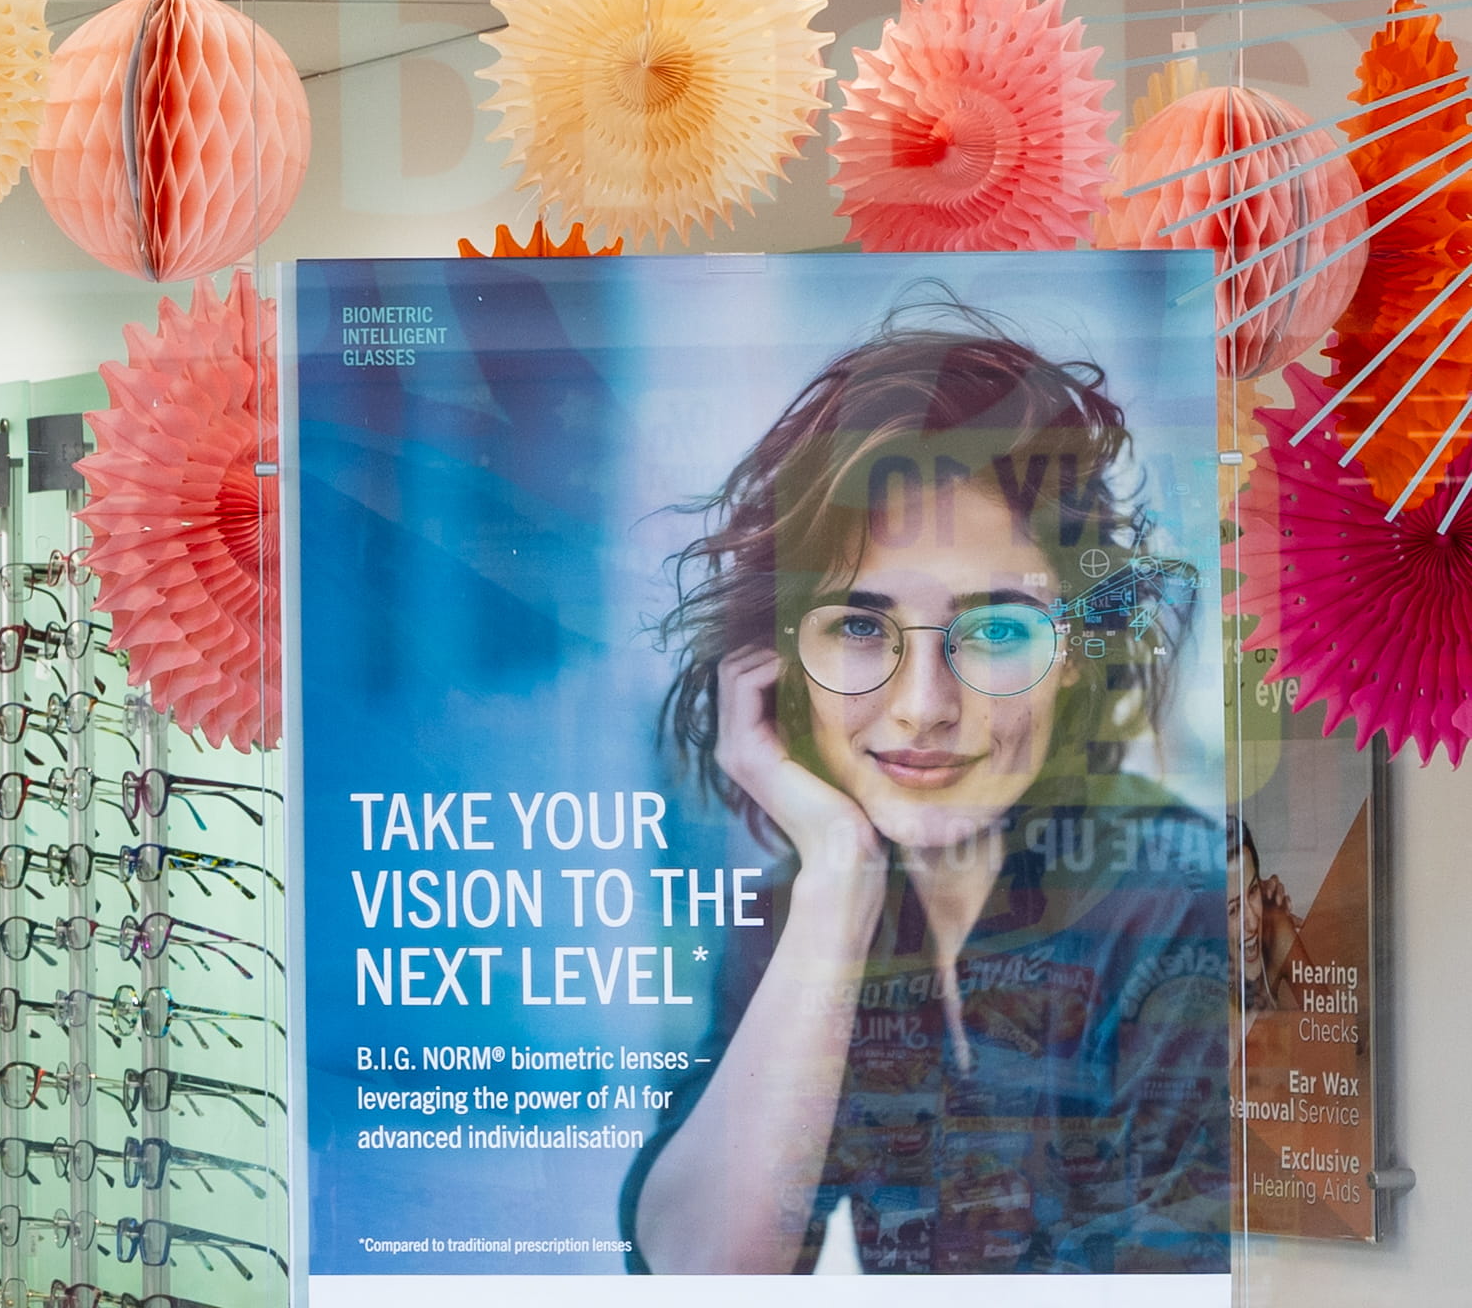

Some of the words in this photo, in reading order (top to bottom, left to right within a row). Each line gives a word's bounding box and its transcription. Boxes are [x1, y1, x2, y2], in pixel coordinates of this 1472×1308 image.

[342, 306, 434, 324] BIOMETRIC
[342, 327, 448, 345] INTELLIGENT
[342, 345, 418, 366] GLASSES
[350, 792, 495, 851] TAKE
[508, 791, 668, 851] YOUR
[351, 869, 543, 929] VISION
[560, 868, 634, 928] TO
[649, 867, 764, 927] THE
[354, 945, 503, 1009] NEXT
[1291, 959, 1358, 990] Hearing
[1303, 989, 1358, 1014] Health
[1298, 1016, 1359, 1044] Checks
[357, 1046, 416, 1071] B.I.G.
[511, 1045, 615, 1070] biometric
[620, 1045, 689, 1070] lenses
[1289, 1069, 1317, 1094] Ear
[1322, 1071, 1359, 1097] Wax
[357, 1085, 469, 1115] leveraging
[472, 1085, 509, 1110] the
[515, 1090, 582, 1115] power
[586, 1084, 609, 1110] of
[613, 1085, 636, 1109] AI
[641, 1084, 674, 1111] for
[1298, 1098, 1360, 1128] Service
[357, 1124, 462, 1149] advanced
[468, 1124, 644, 1149] individualisation
[1281, 1146, 1360, 1176] Exclusive
[1252, 1173, 1317, 1206] Hearing
[1322, 1178, 1362, 1206] Aids
[431, 1238, 444, 1252] to
[447, 1237, 511, 1252] traditional
[514, 1237, 589, 1255] prescription
[592, 1238, 632, 1252] lenses
